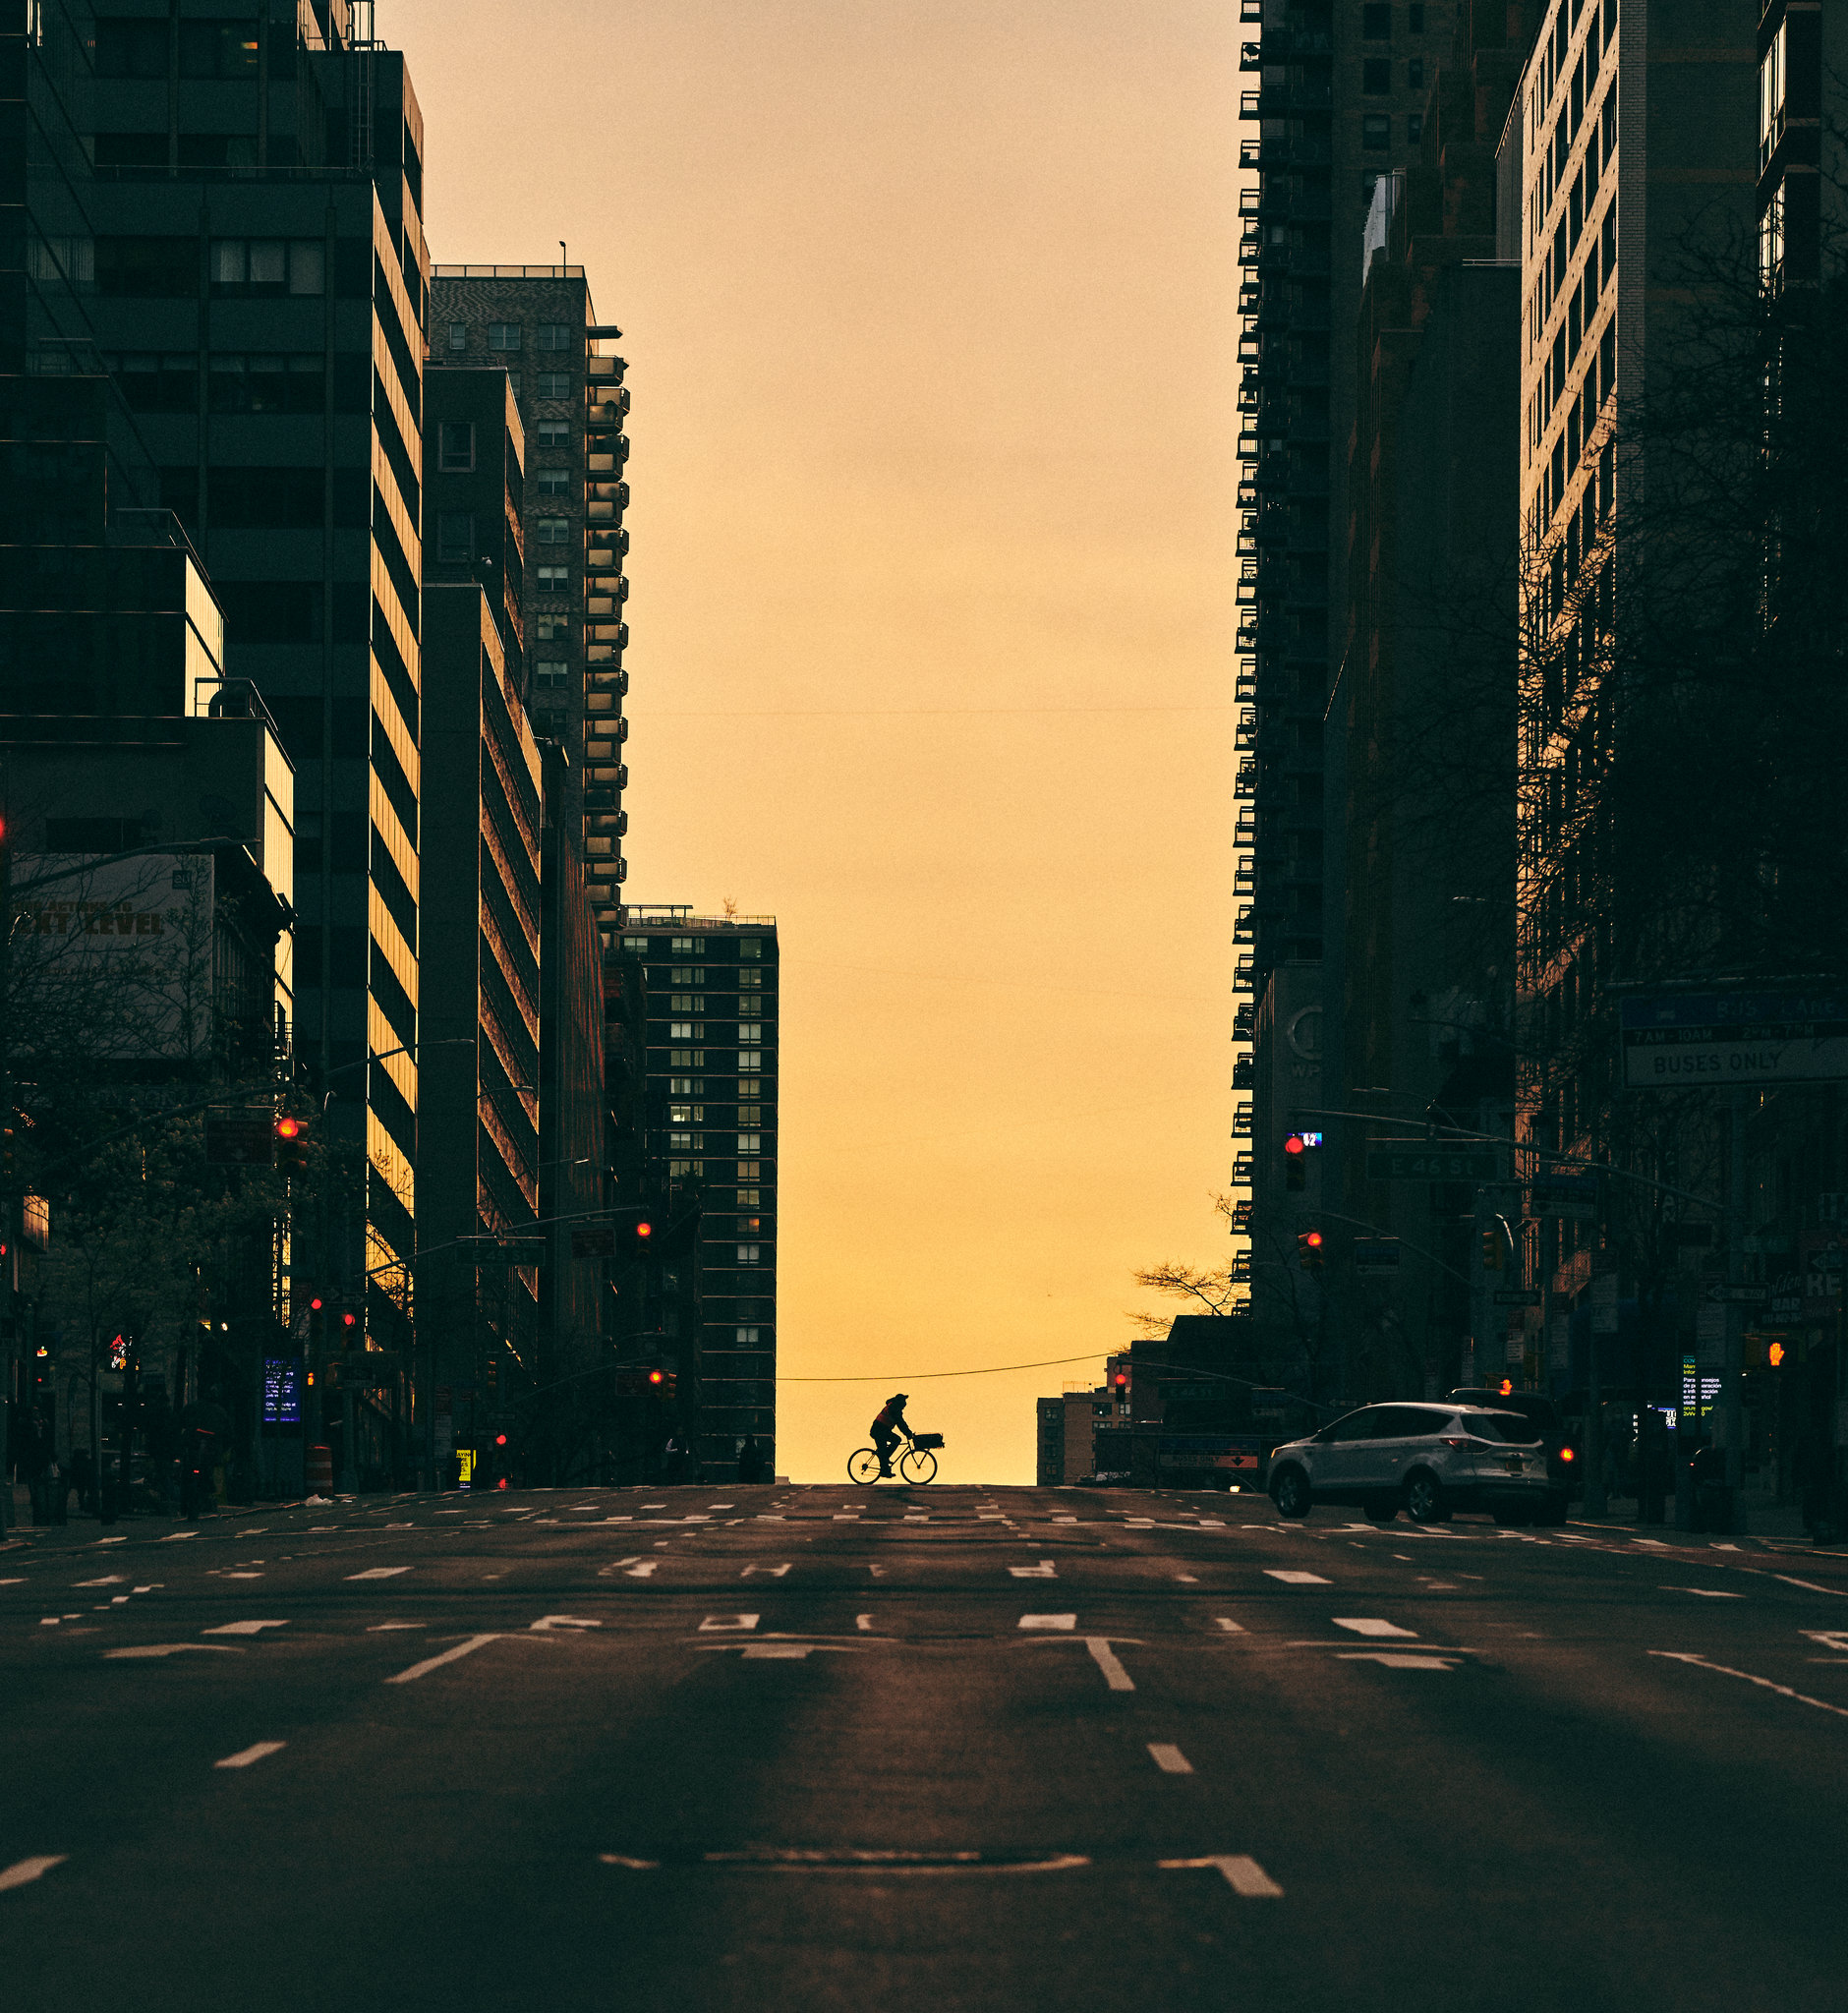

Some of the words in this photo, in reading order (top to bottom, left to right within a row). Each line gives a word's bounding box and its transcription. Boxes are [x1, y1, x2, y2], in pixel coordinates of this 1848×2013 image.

[86, 913, 164, 935] LEVEL
[1716, 1000, 1758, 1018] BUS
[1653, 1054, 1720, 1074] BUSES
[1729, 1050, 1783, 1071] ONLY
[1391, 1158, 1404, 1175] E
[1412, 1158, 1441, 1175] 46
[1449, 1158, 1473, 1176] St
[472, 1248, 481, 1261] E
[485, 1249, 506, 1261] 45
[512, 1249, 528, 1262] St
